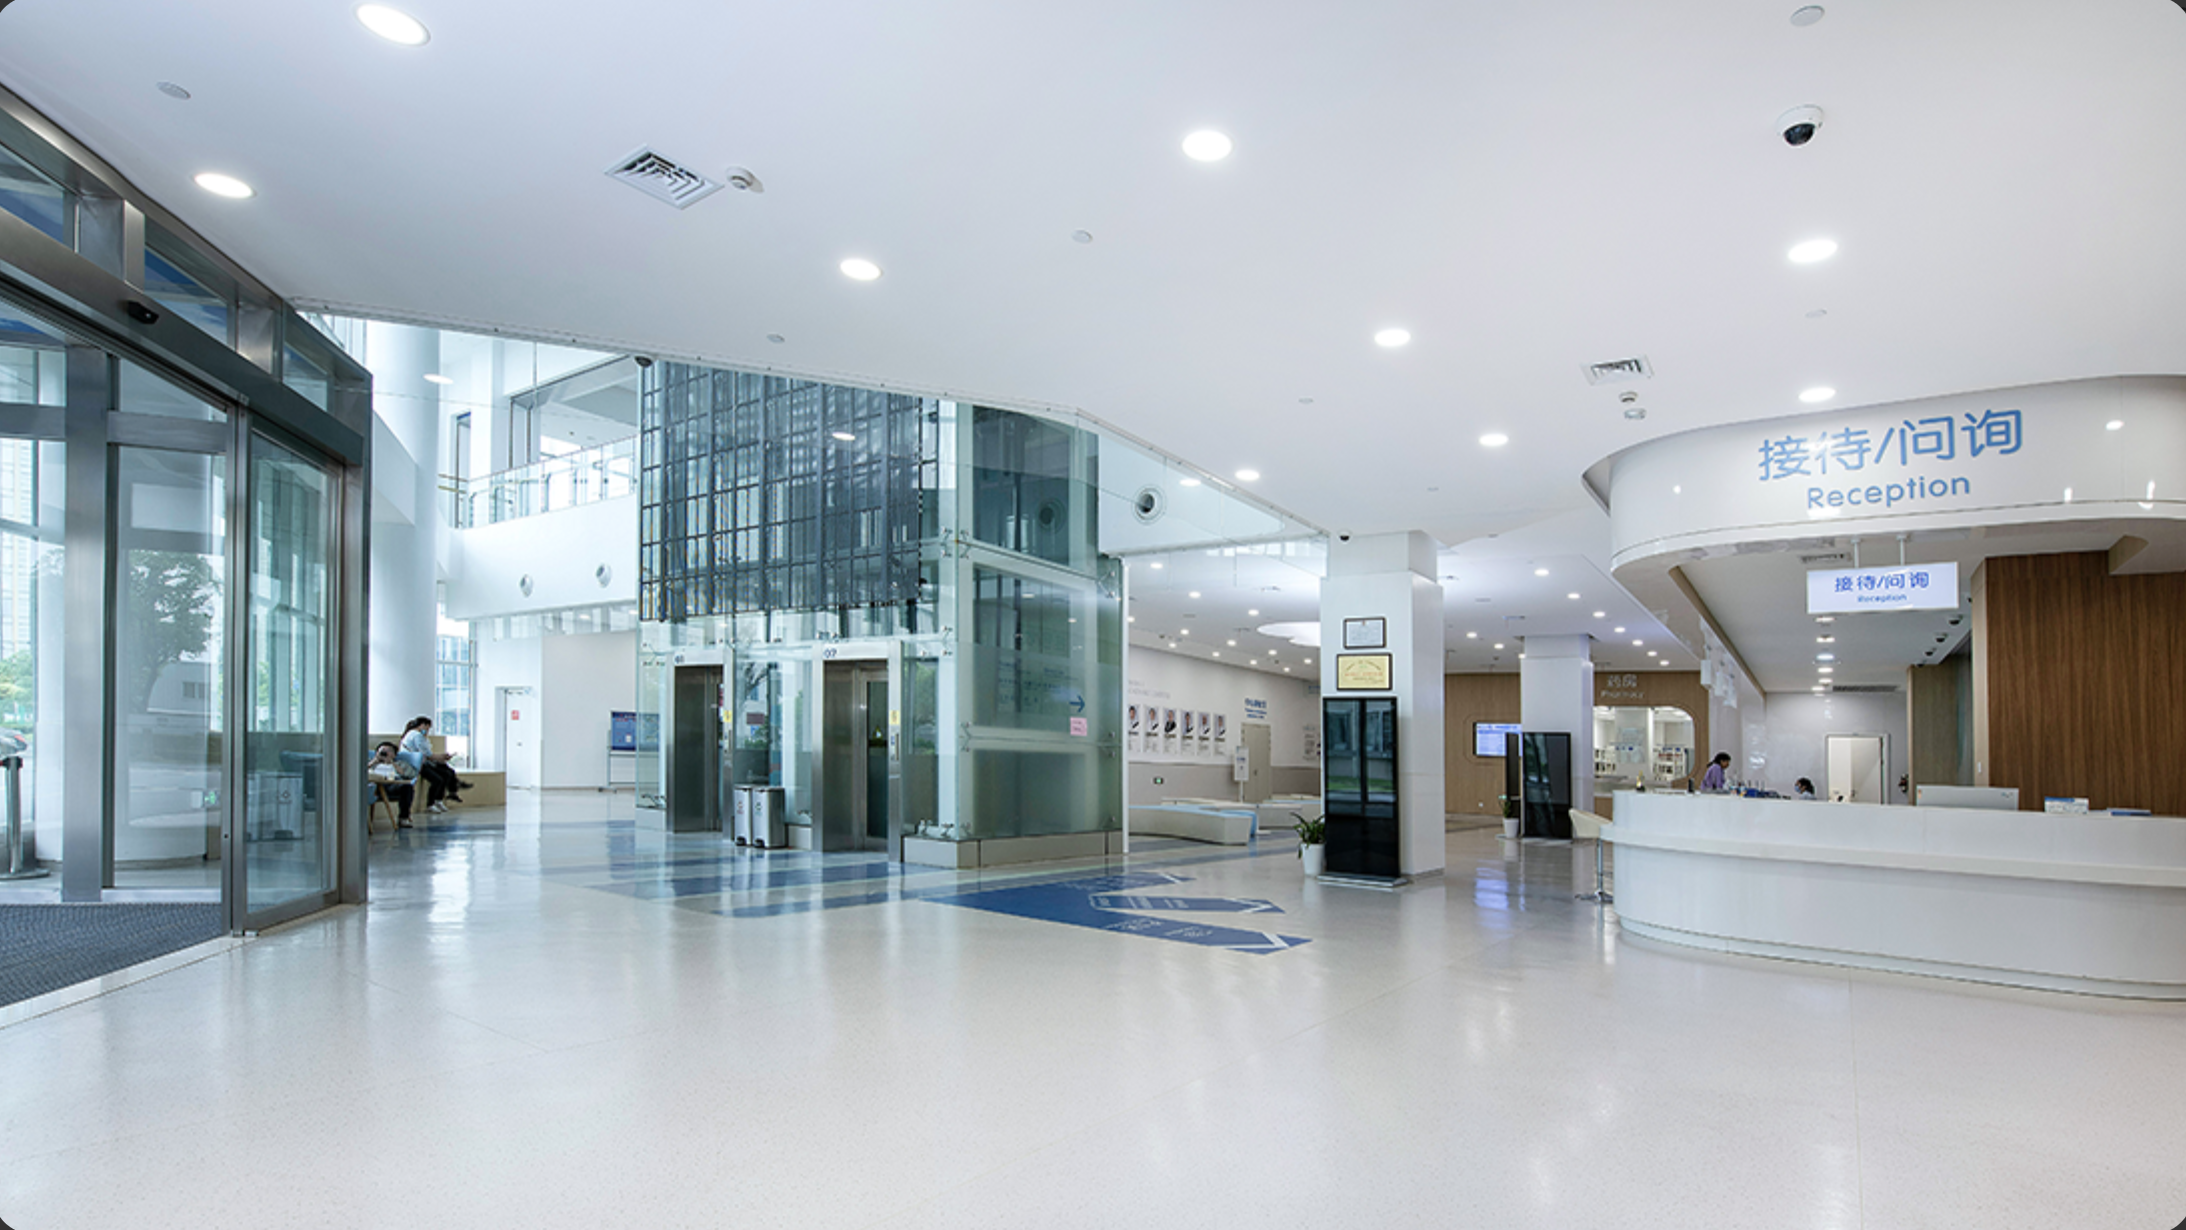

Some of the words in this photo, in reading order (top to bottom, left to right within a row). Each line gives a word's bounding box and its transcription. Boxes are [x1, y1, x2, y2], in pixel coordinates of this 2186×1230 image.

[1759, 409, 2022, 480] 接待/问询
[1807, 476, 1970, 508] Reception
[1834, 571, 1930, 592] 接待/问询
